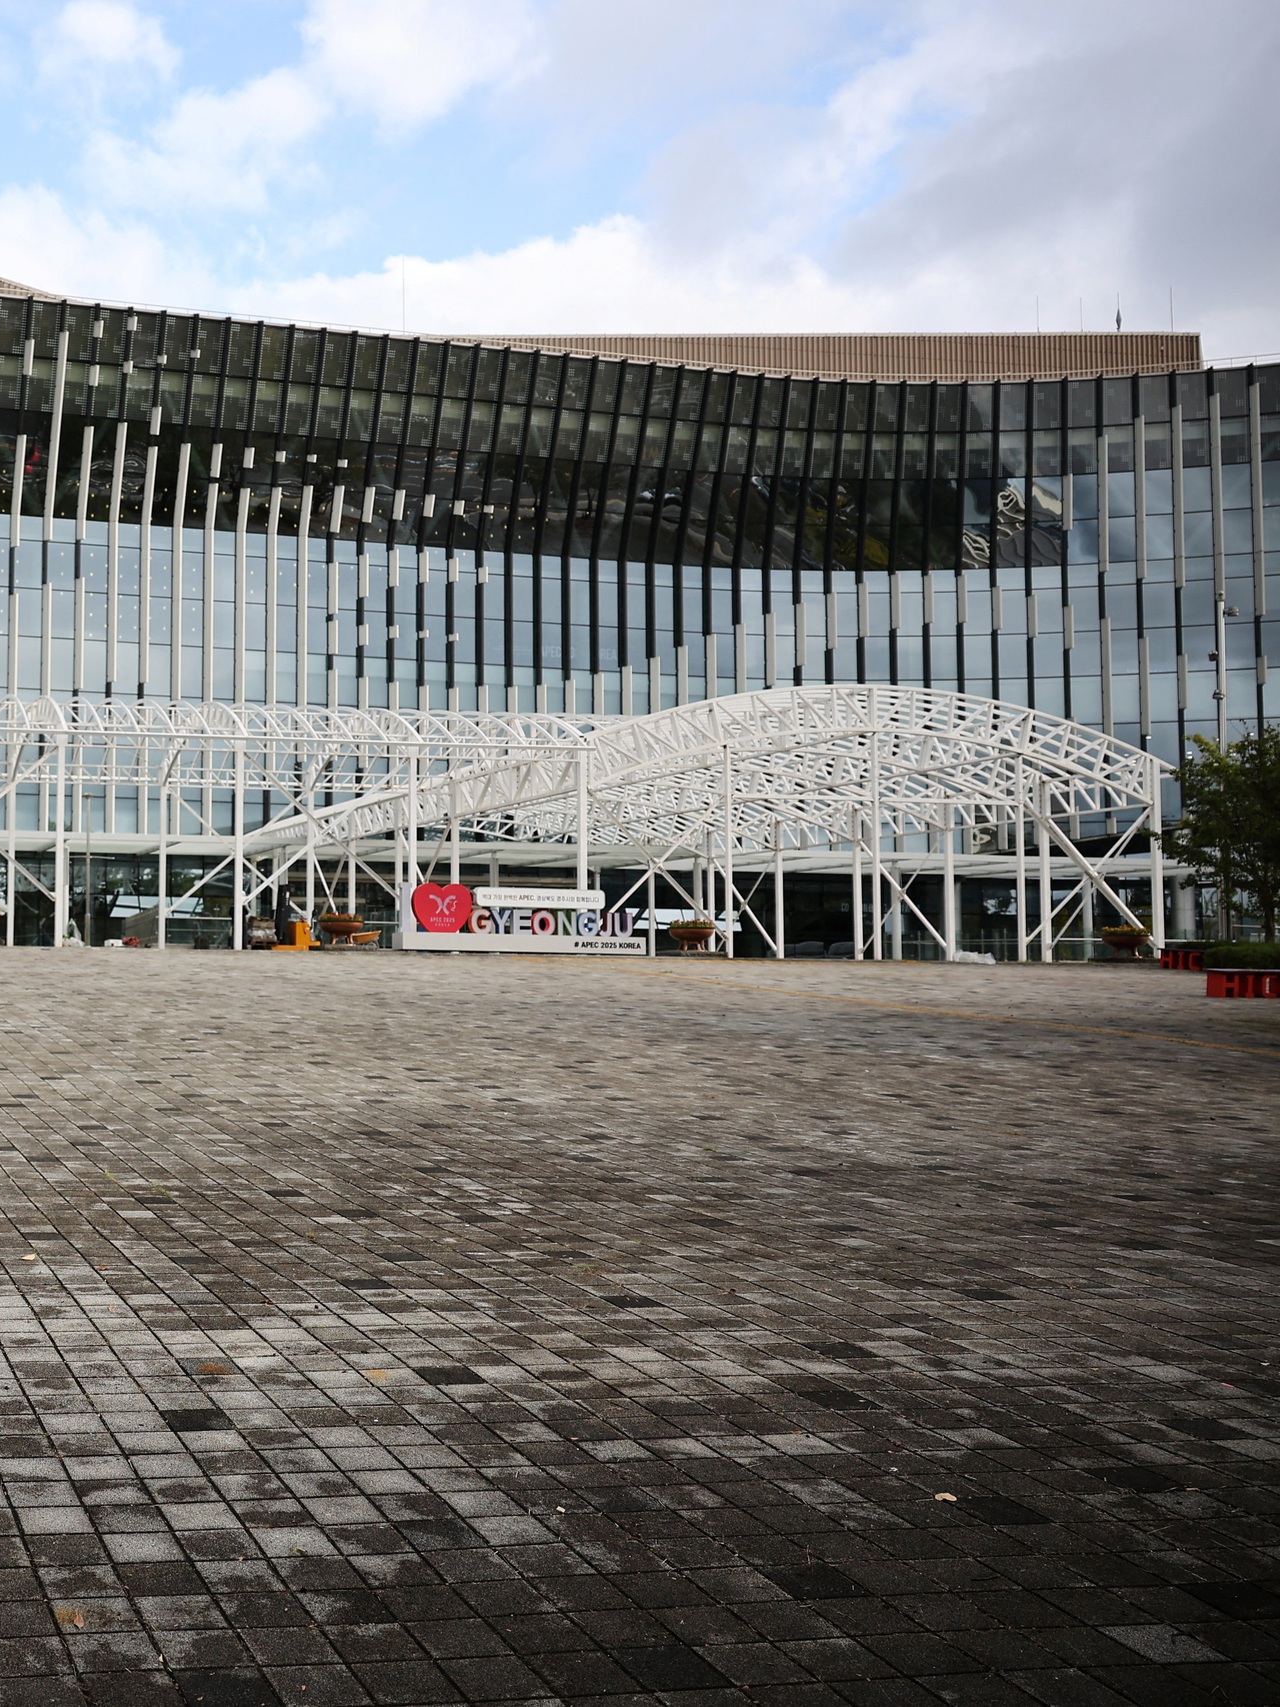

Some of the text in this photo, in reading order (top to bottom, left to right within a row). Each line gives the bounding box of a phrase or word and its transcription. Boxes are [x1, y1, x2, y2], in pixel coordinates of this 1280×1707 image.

[470, 909, 634, 938] GYEONGJU
[619, 942, 642, 950] KOREA
[1160, 949, 1203, 971] HIC
[1219, 974, 1278, 999] HIC
